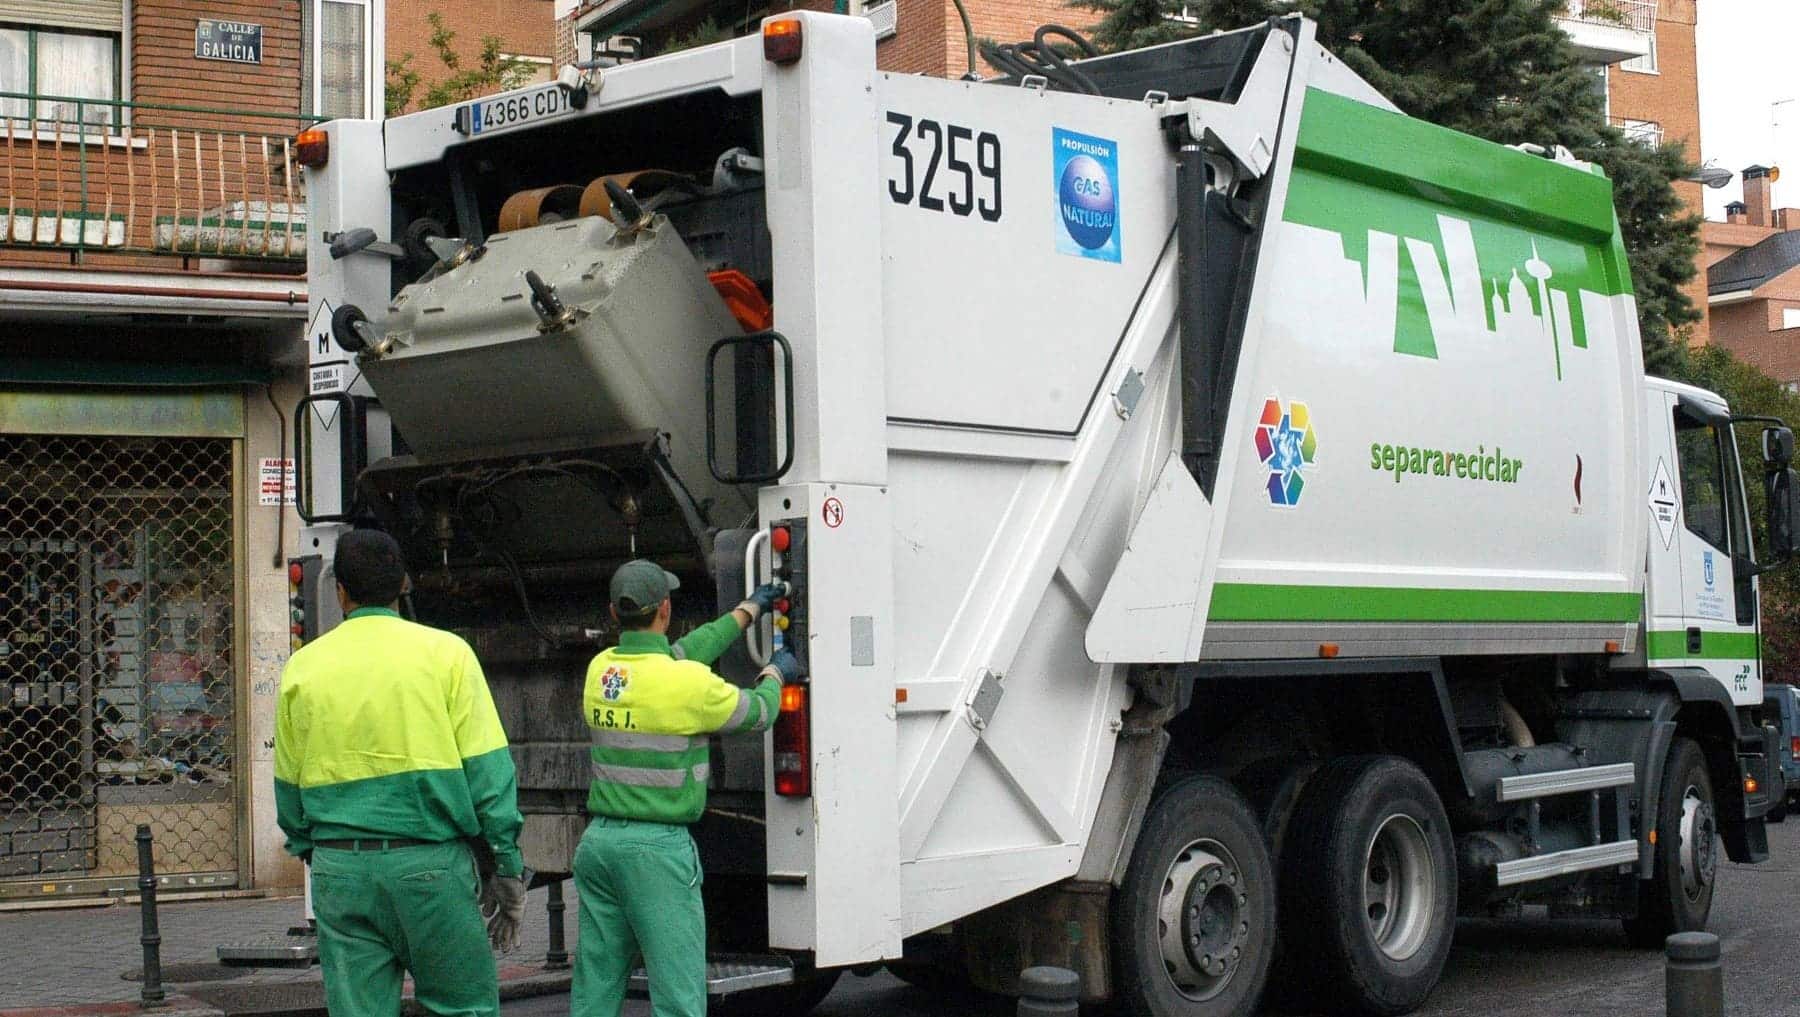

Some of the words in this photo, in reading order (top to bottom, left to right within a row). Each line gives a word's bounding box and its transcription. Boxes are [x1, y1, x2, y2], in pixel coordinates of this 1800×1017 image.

[218, 22, 255, 35] CALLE
[203, 41, 255, 61] GALICIA
[484, 96, 529, 127] 4366
[535, 88, 570, 116] CDY
[1061, 137, 1110, 158] PROPULSIÓN
[886, 110, 1002, 222] 3259
[1073, 176, 1102, 197] GAS
[1063, 204, 1113, 228] NATURAL
[318, 332, 330, 354] M
[1370, 442, 1522, 483] separareciclar
[1659, 480, 1666, 496] M
